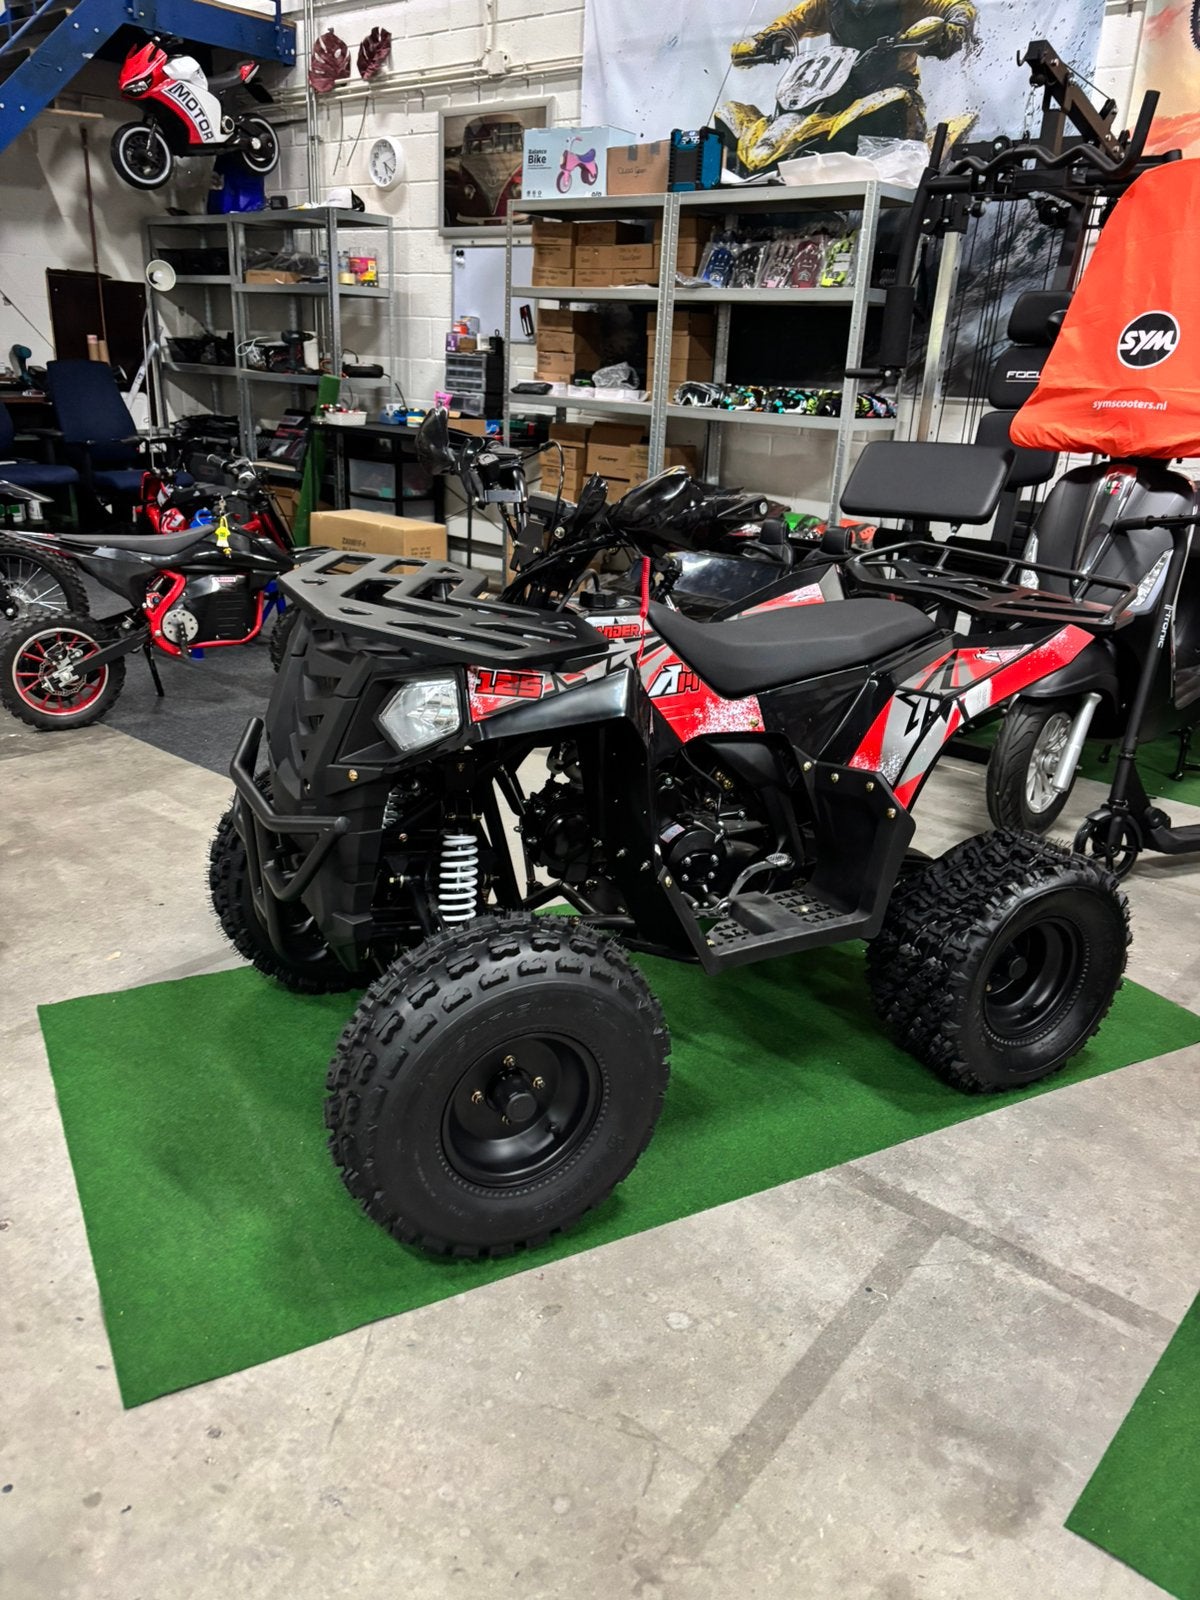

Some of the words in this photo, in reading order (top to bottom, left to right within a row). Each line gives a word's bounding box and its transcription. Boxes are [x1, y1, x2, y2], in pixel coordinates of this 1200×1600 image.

[527, 155, 547, 164] Bike
[1119, 330, 1176, 356] SYM
[1091, 400, 1168, 411] symscooters.nl
[475, 670, 544, 698] 125
